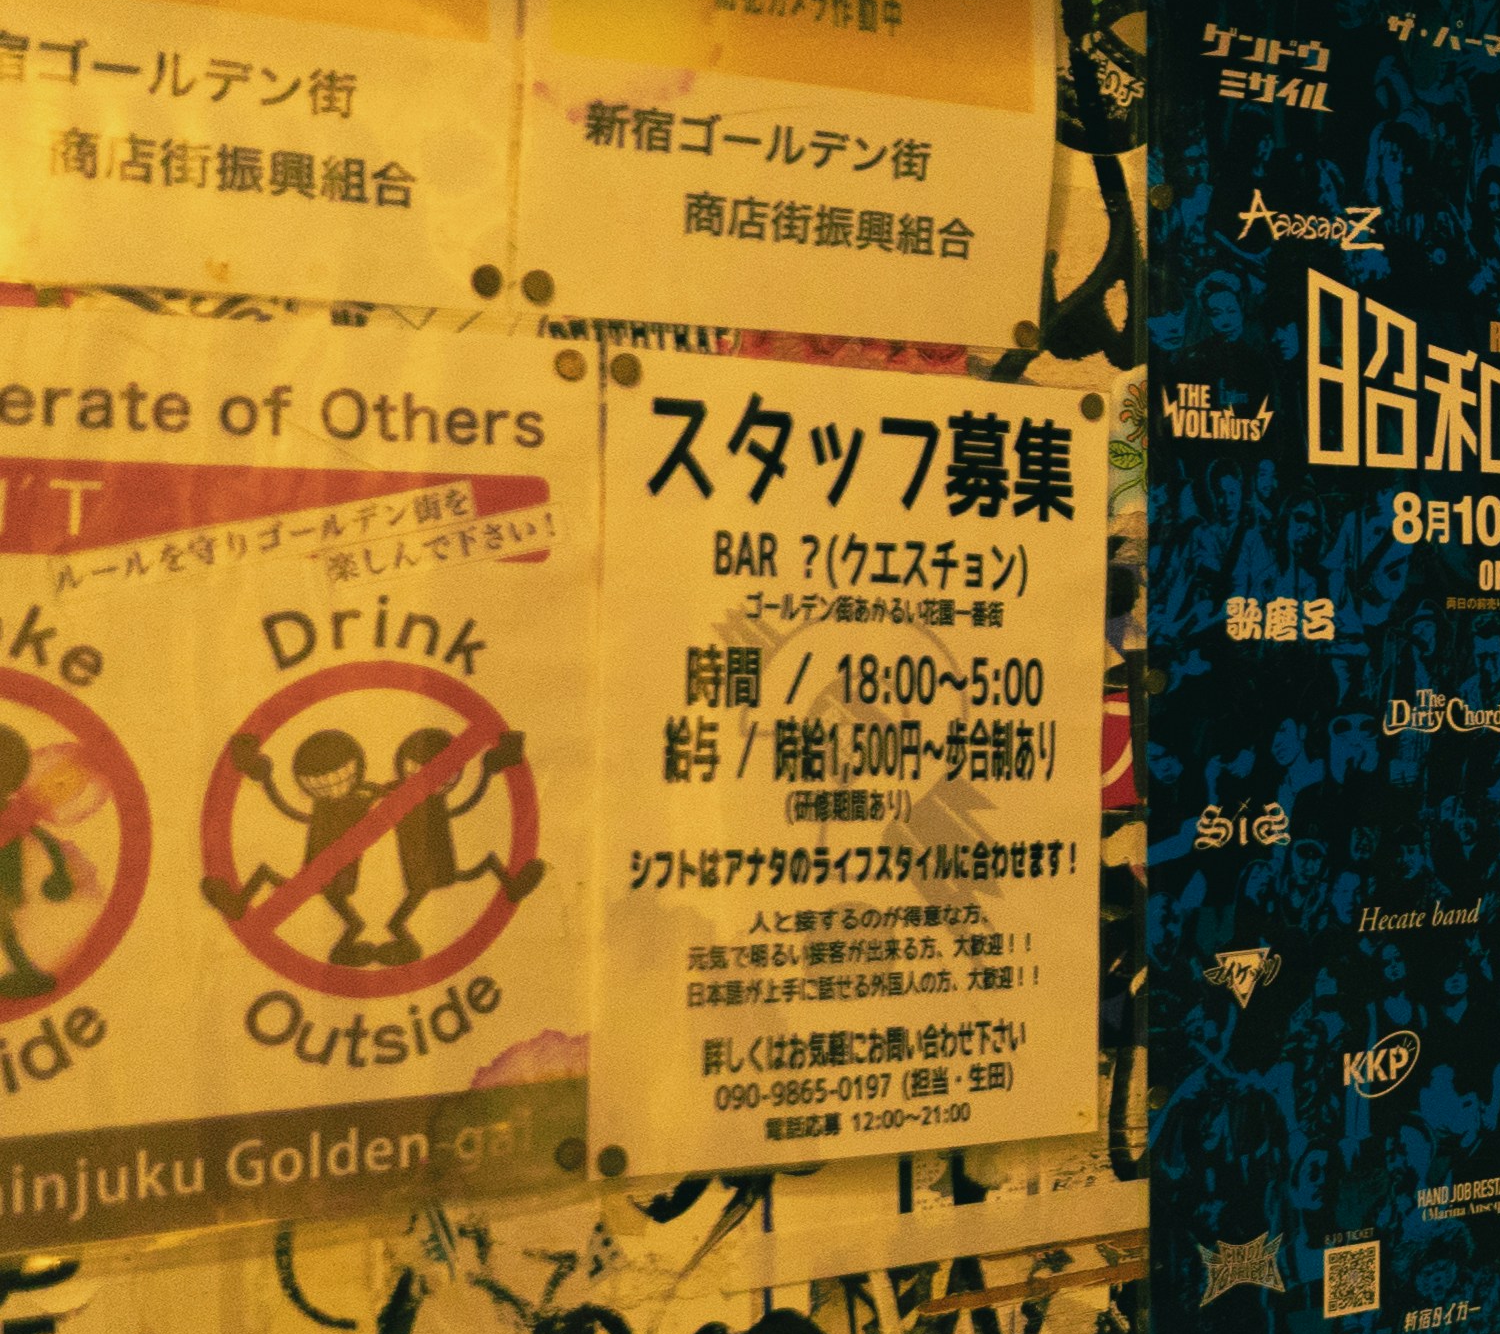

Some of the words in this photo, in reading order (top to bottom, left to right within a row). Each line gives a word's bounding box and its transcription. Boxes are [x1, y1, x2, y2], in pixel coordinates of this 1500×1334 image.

[1199, 22, 1331, 74] ゲンドウ
[1218, 68, 1335, 114] ミサイル
[584, 98, 932, 183] 新宿ゴールデン街
[50, 125, 418, 210] 商店街振興組合
[683, 189, 976, 261] 商店街振興組合
[218, 384, 293, 436] of
[320, 386, 546, 449] Others
[1176, 381, 1213, 410] THE
[646, 391, 1076, 523] スタッフ募集
[712, 531, 779, 578] BAR
[744, 591, 1005, 629] ゴールデン街あかるい花園一番街
[261, 595, 487, 675] Drink
[685, 645, 763, 709] 時間
[1415, 688, 1447, 711] The
[1382, 698, 1445, 737] Dirty
[664, 715, 721, 784] 給与
[1357, 906, 1426, 934] Hecate
[1430, 897, 1483, 927] band
[243, 974, 502, 1067] Outside
[701, 1019, 1027, 1077] 詳しくはお気軽にお問い合わせ下さい
[1341, 1041, 1411, 1088] KKP
[714, 1072, 892, 1111] 090-9865-0197
[764, 1111, 842, 1142] 電話応募
[1416, 1185, 1446, 1208] HAND
[1448, 1182, 1470, 1204] JOB
